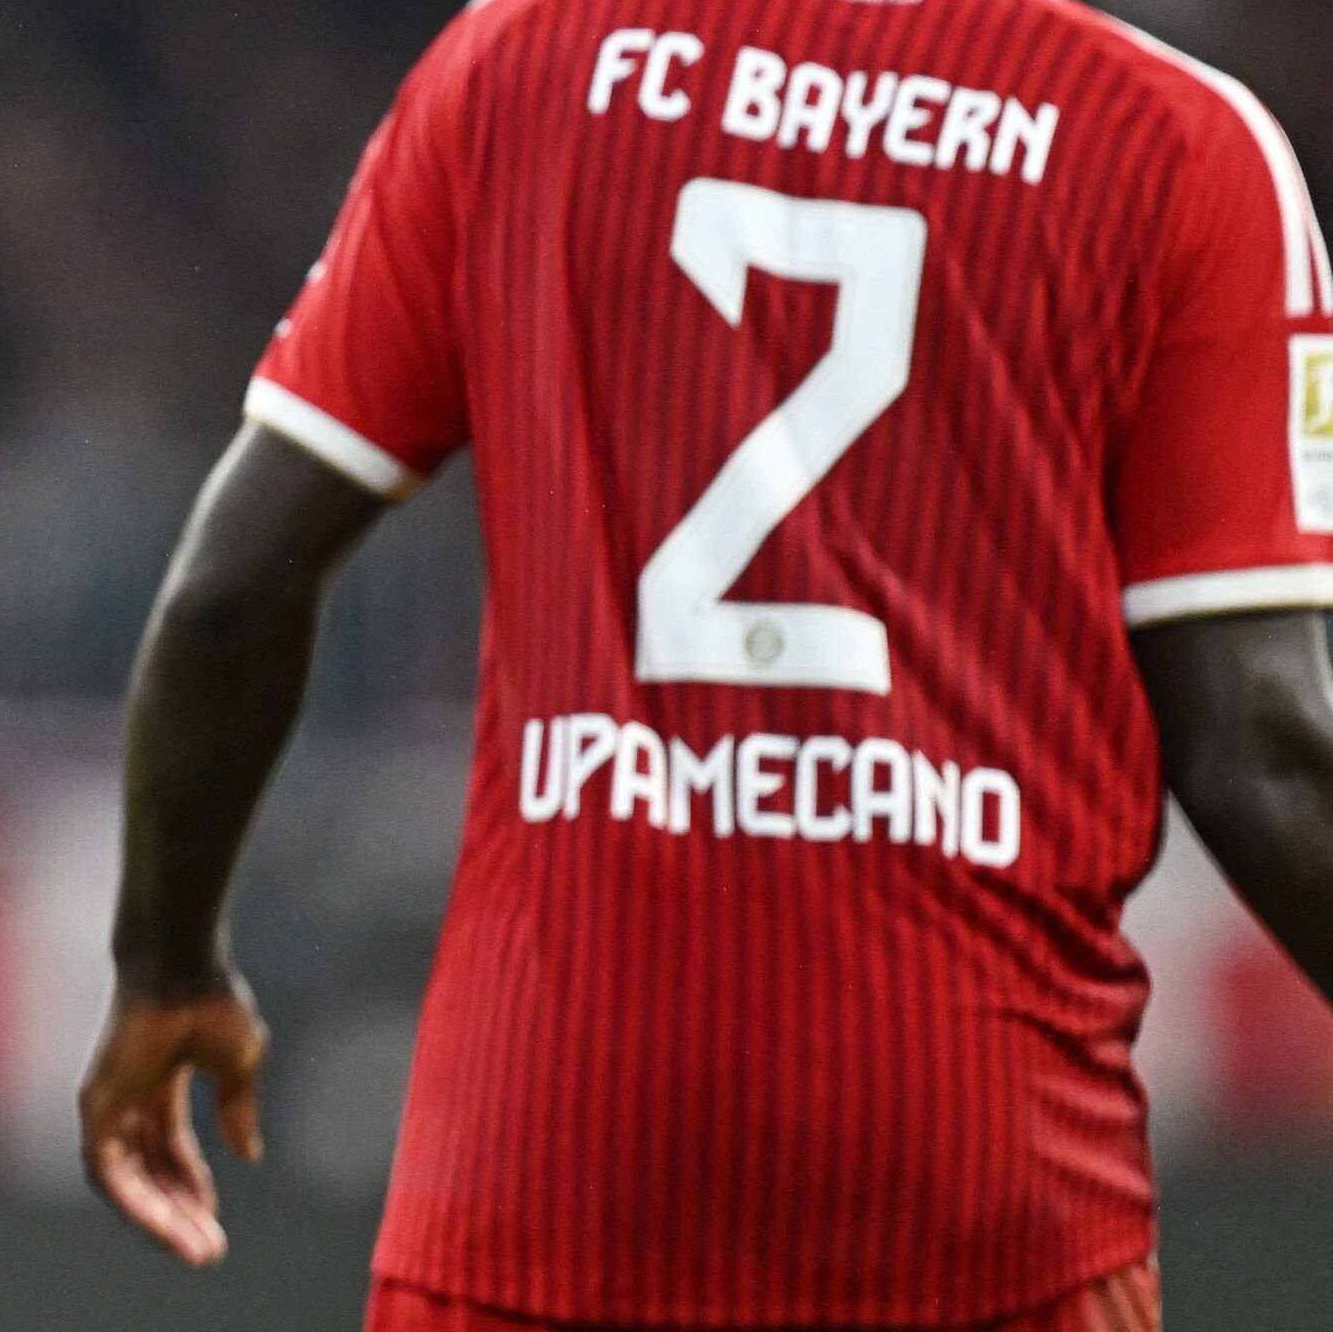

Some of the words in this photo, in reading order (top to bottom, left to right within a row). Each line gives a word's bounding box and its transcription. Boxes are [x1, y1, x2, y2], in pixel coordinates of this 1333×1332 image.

[586, 27, 705, 122] FC
[721, 45, 1060, 185] BAYERN
[633, 175, 929, 698] 2
[518, 711, 1021, 868] UPAMECANO
